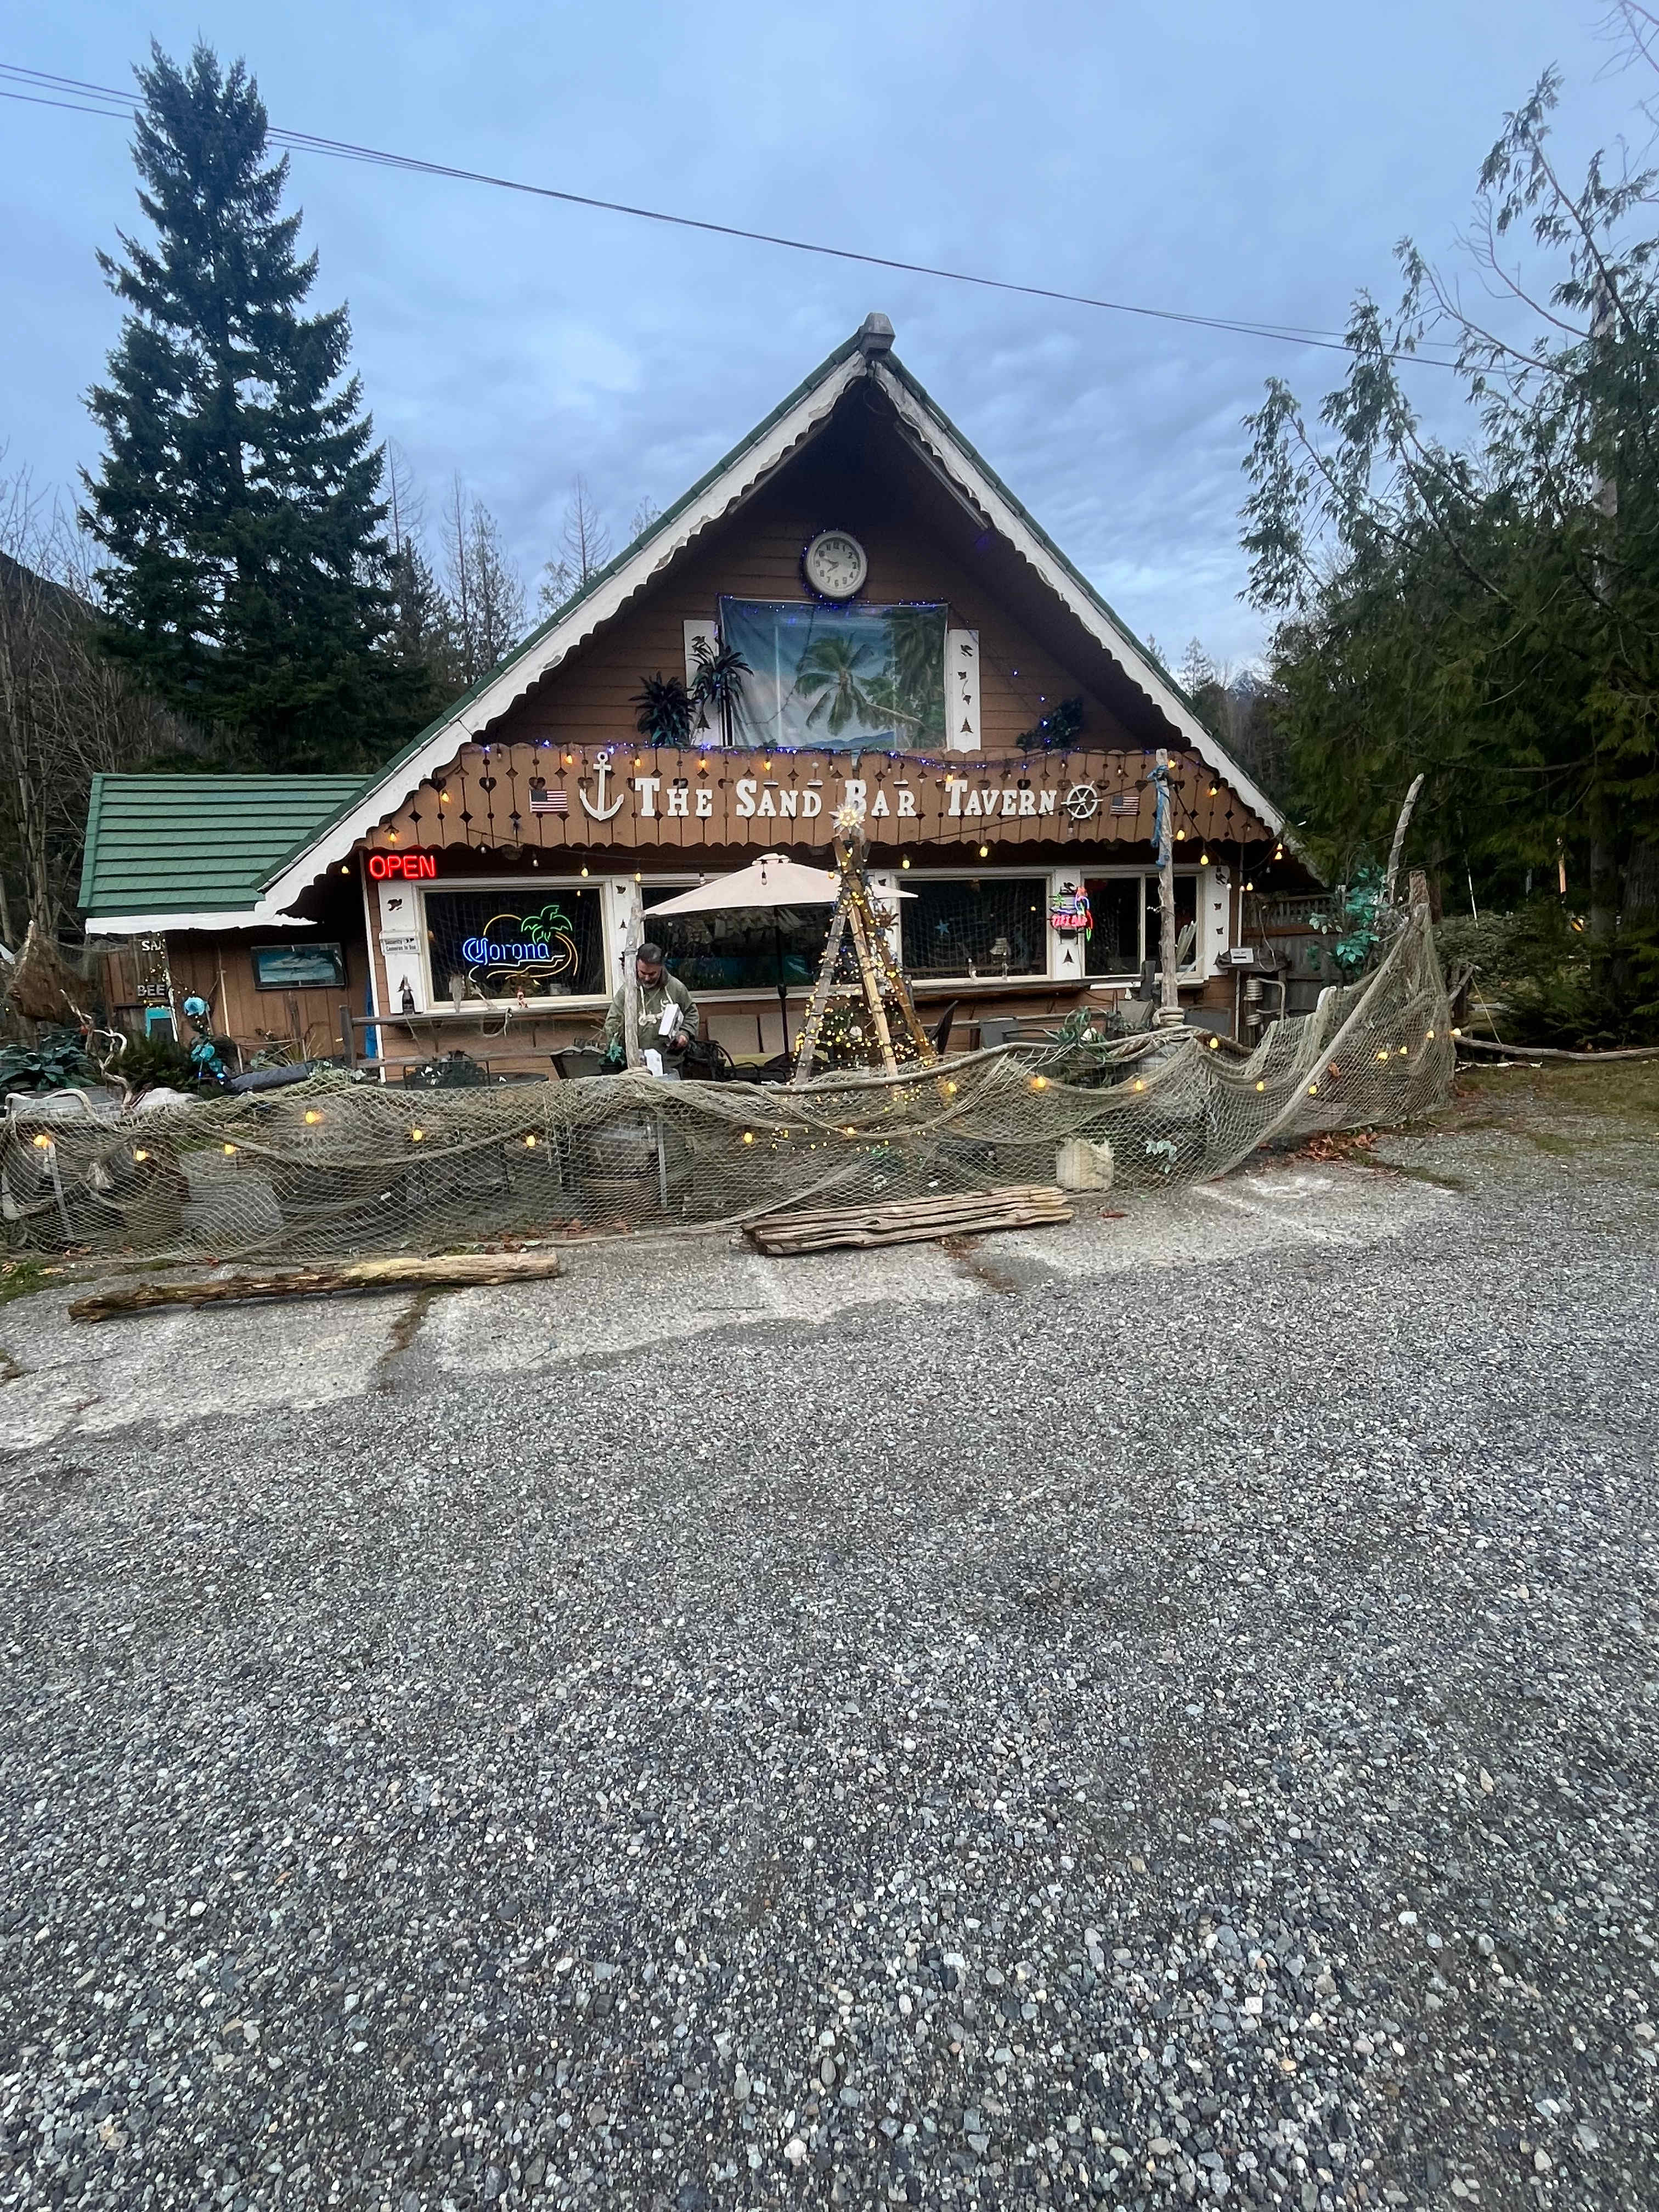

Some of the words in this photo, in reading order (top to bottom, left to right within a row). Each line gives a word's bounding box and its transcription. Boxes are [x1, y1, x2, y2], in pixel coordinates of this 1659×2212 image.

[634, 778, 713, 816] THE
[736, 779, 822, 817] SAND
[845, 780, 916, 816] BAR
[945, 780, 1057, 816] TAVERN
[369, 855, 435, 878] OPEN
[462, 938, 550, 966] Corona
